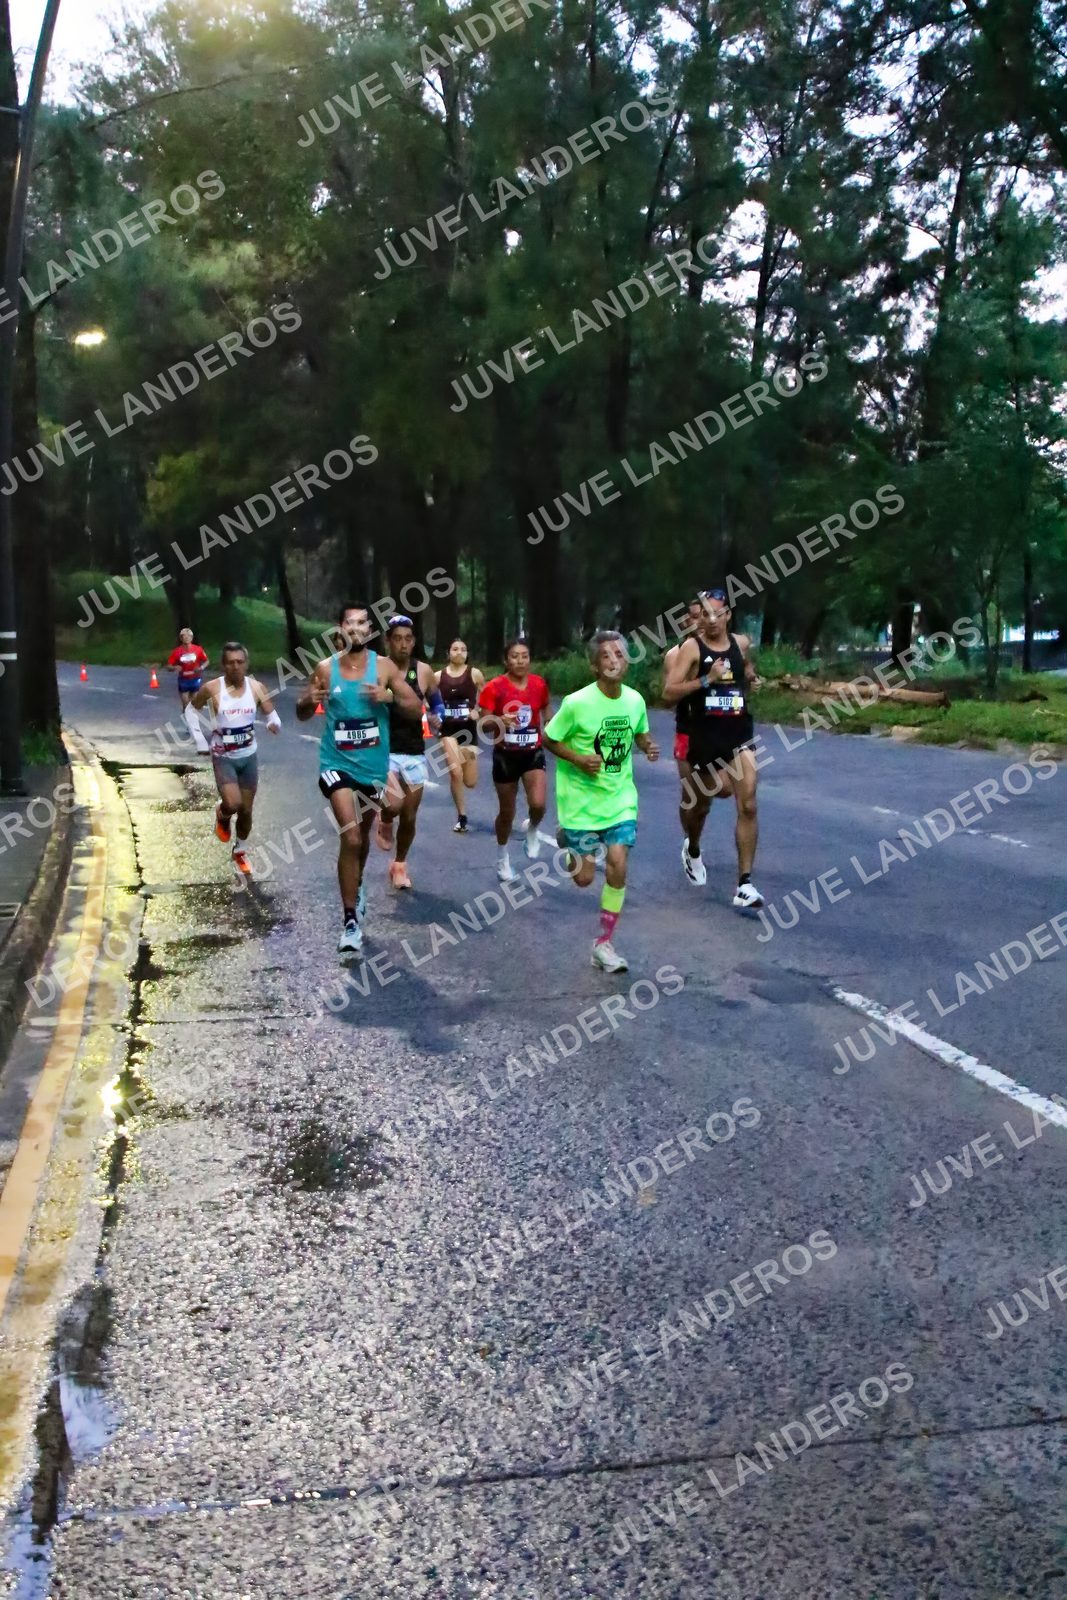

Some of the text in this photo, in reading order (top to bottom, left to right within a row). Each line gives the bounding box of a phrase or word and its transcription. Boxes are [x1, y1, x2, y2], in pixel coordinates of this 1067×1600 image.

[718, 697, 733, 706] 5102
[604, 719, 628, 727] BIMBO
[347, 730, 367, 740] 4985
